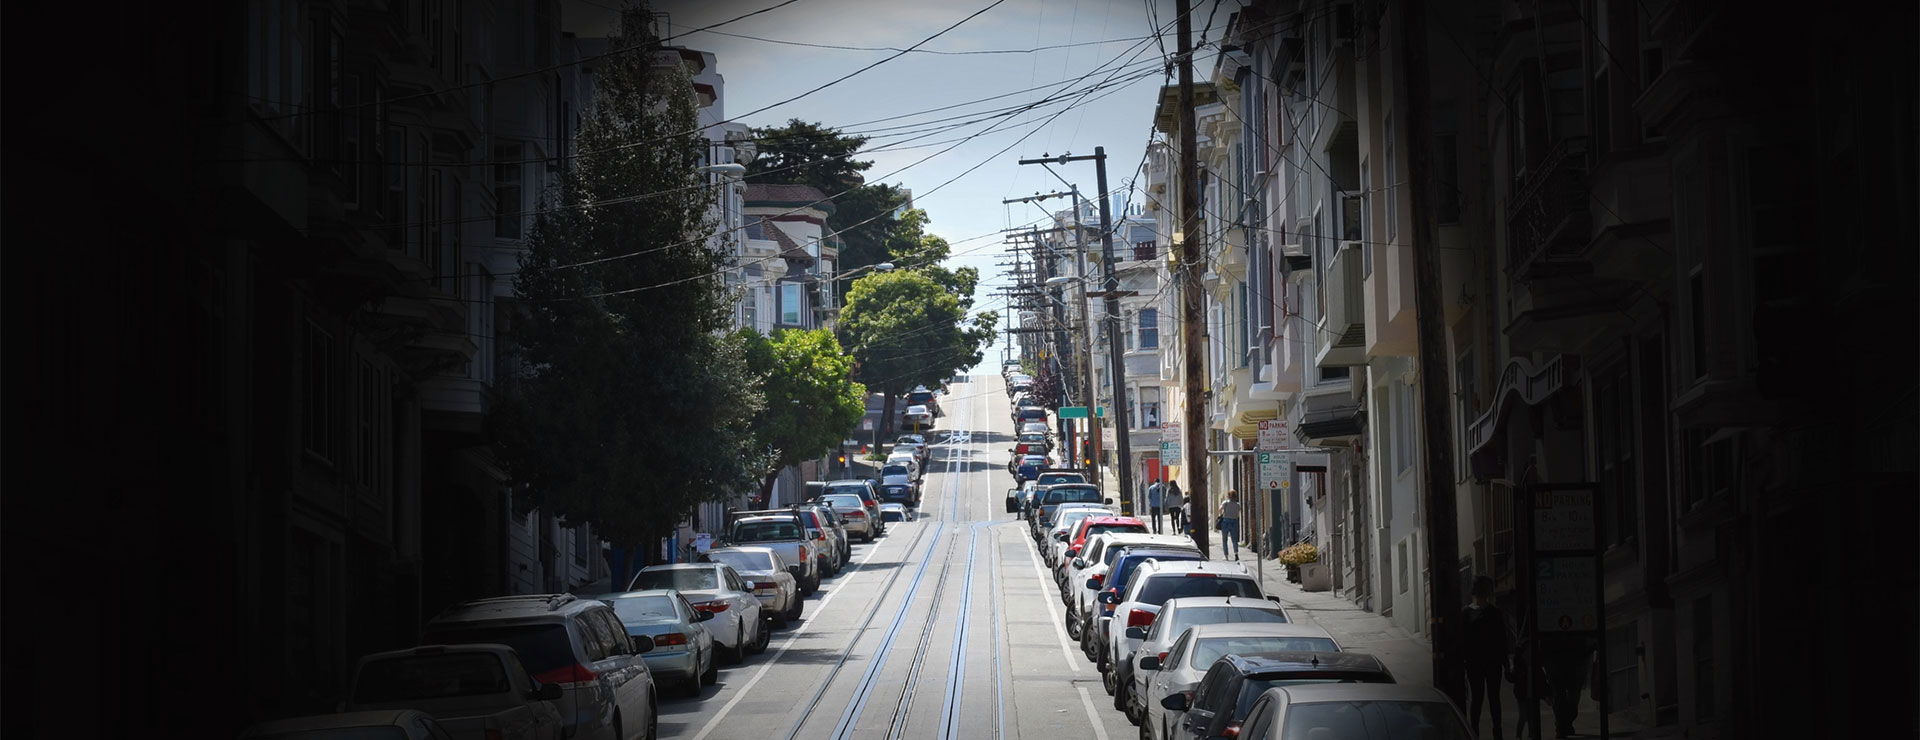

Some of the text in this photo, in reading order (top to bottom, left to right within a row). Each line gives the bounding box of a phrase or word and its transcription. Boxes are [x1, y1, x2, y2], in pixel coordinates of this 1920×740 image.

[1535, 491, 1592, 507] NO PARKING
[1538, 561, 1552, 577] 2
